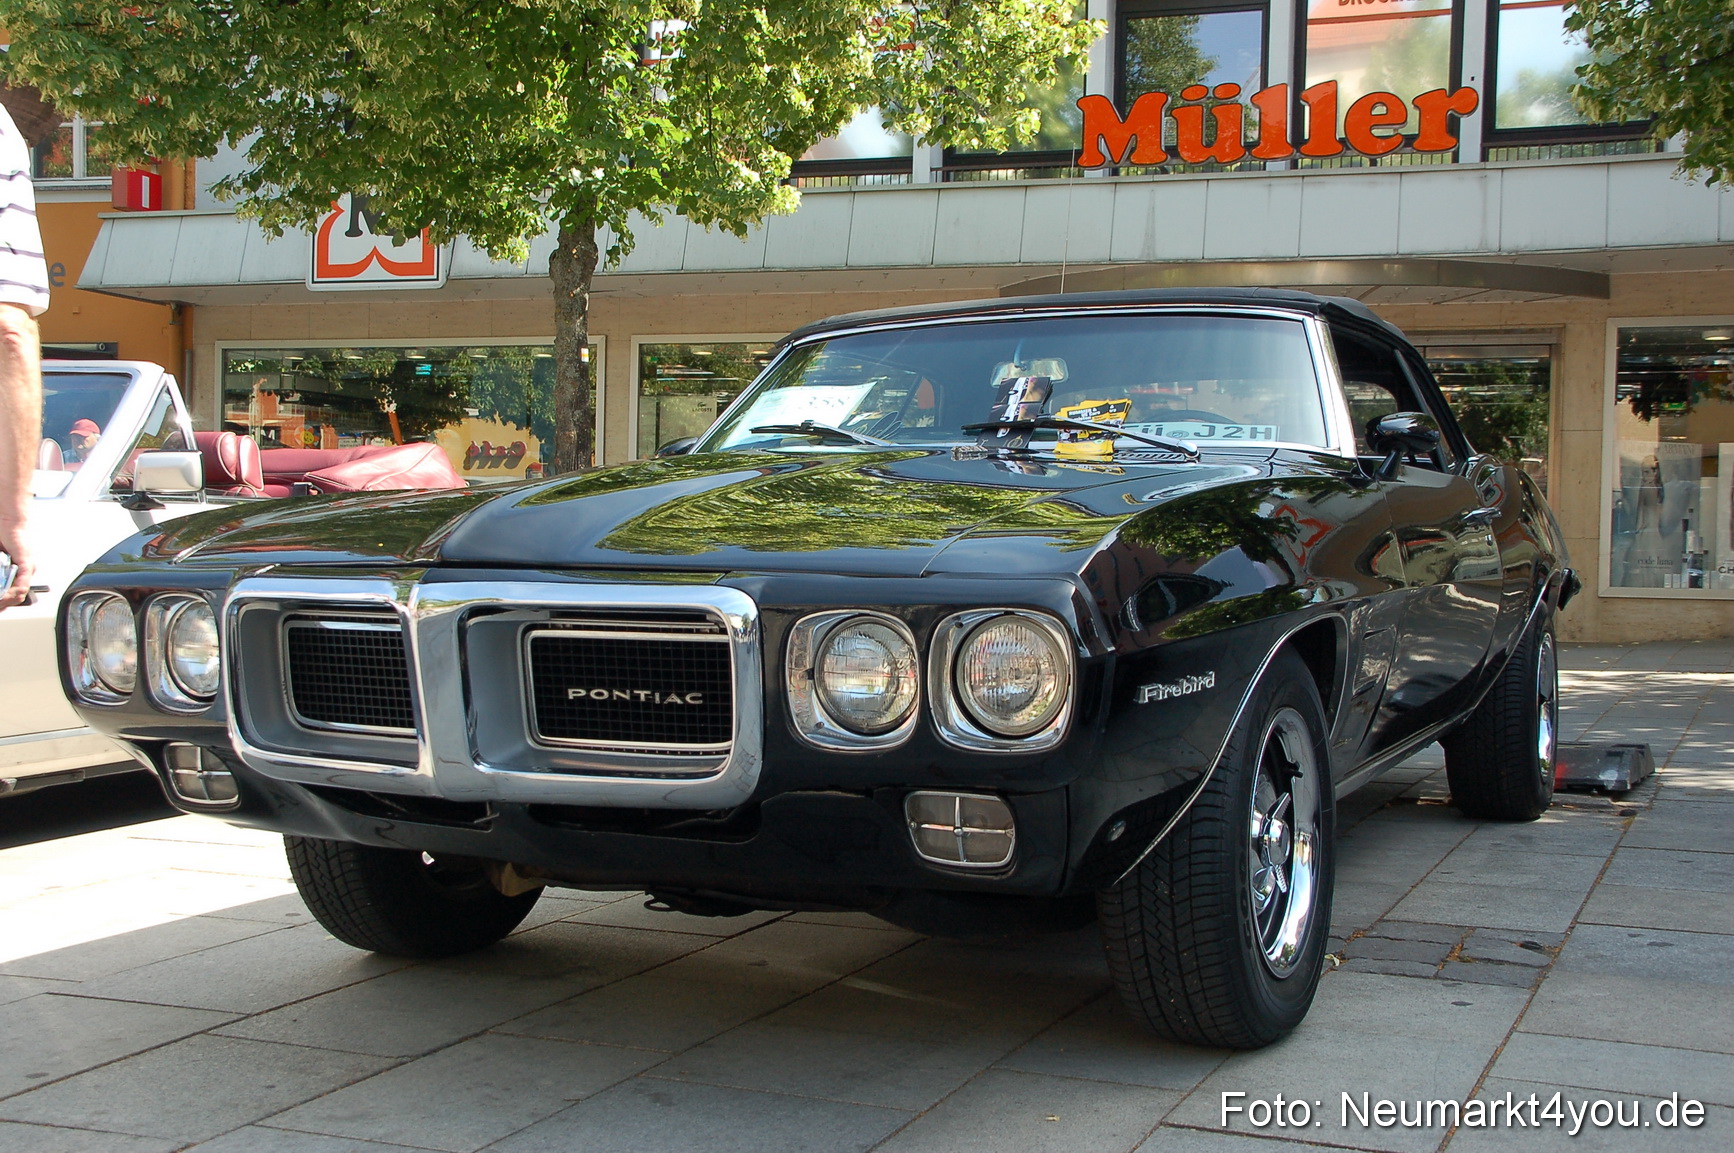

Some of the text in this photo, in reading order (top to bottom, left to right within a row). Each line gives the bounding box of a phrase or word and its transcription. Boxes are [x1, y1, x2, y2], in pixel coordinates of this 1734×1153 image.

[1077, 80, 1479, 168] Müller
[567, 688, 703, 705] PONTIAC
[1136, 670, 1216, 704] Firebird
